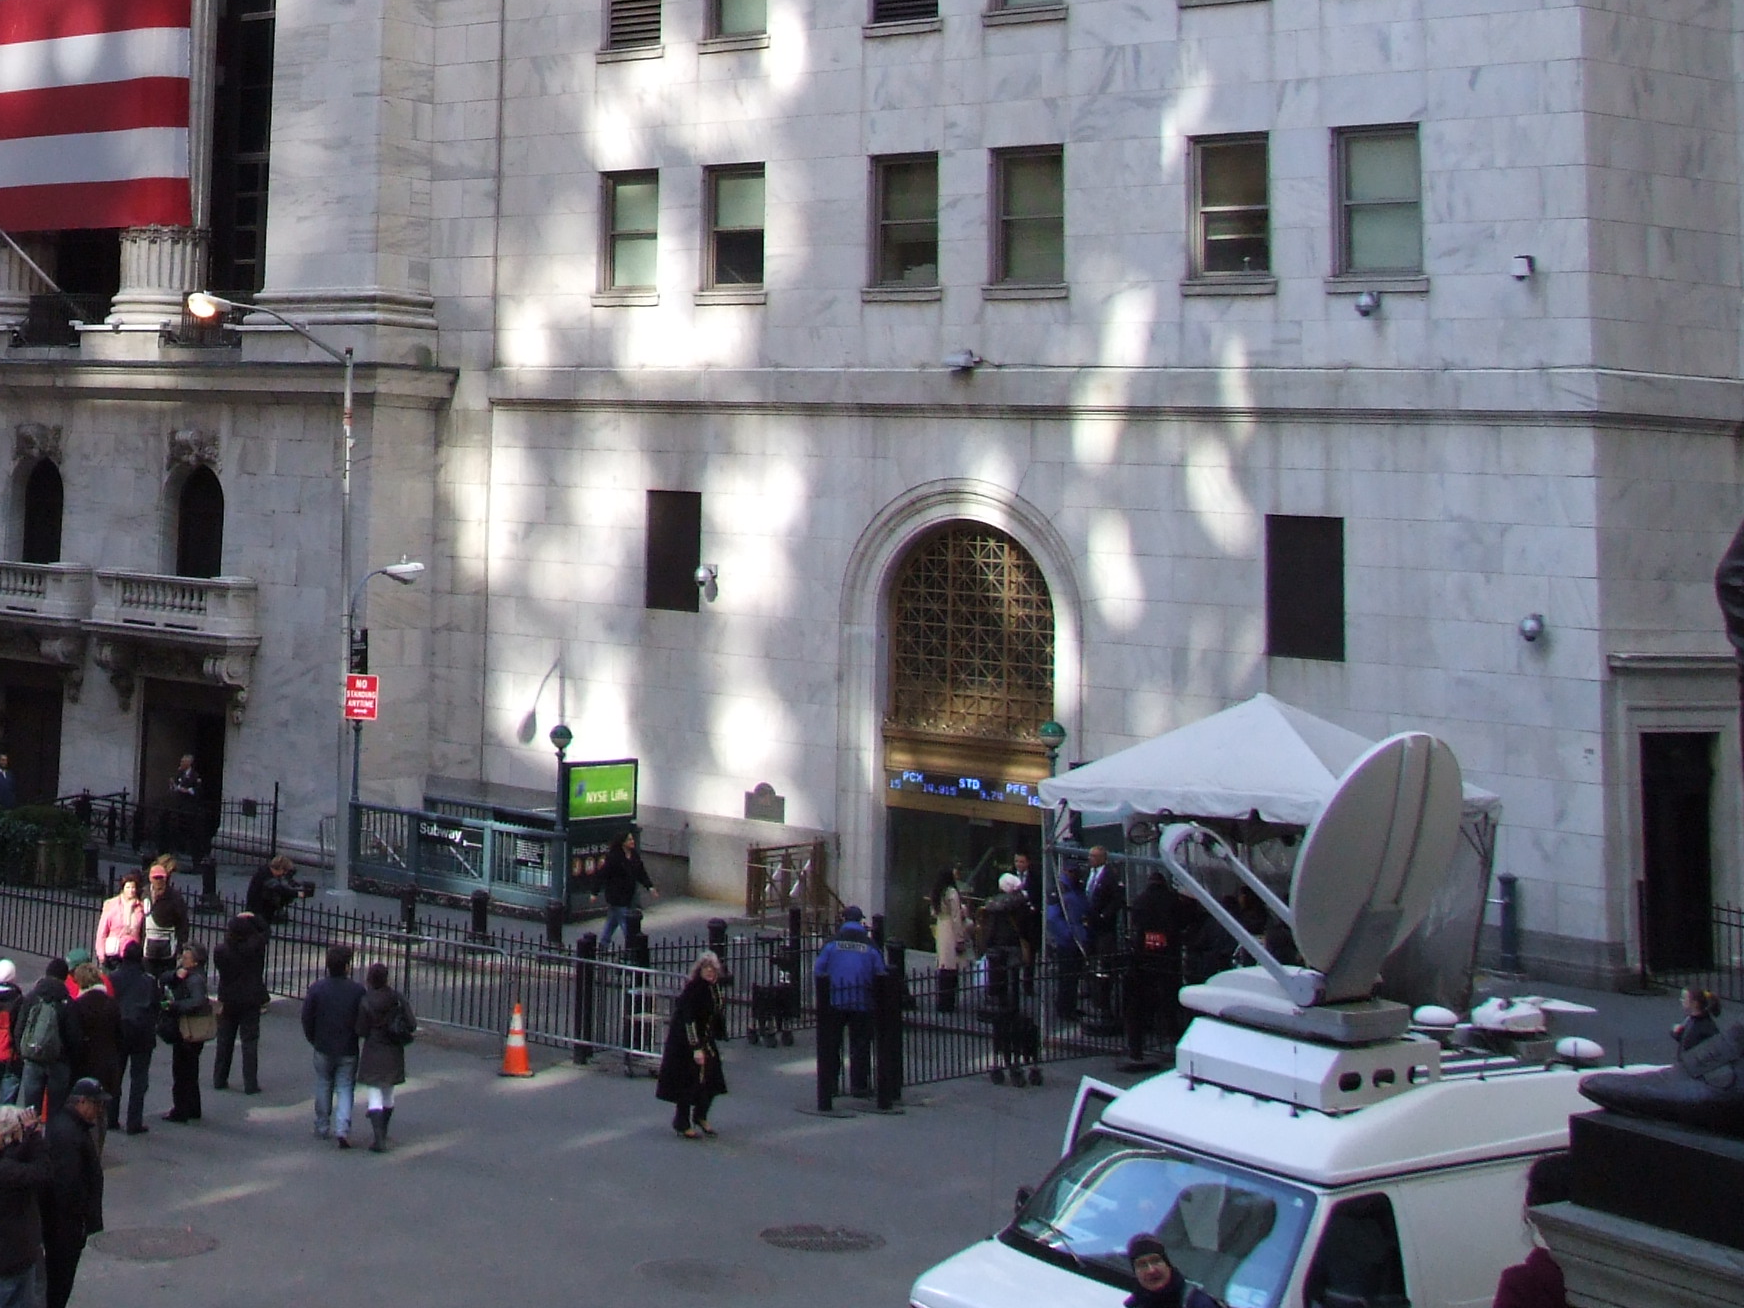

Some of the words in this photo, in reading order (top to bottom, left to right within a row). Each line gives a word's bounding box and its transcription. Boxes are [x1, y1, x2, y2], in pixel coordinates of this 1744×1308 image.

[355, 678, 368, 689] NO
[347, 690, 376, 699] STANDING
[348, 699, 375, 708] ANYTIME
[958, 778, 981, 790] STD
[1006, 783, 1028, 796] PFE
[585, 791, 608, 804] NYSE
[419, 822, 462, 843] Subway
